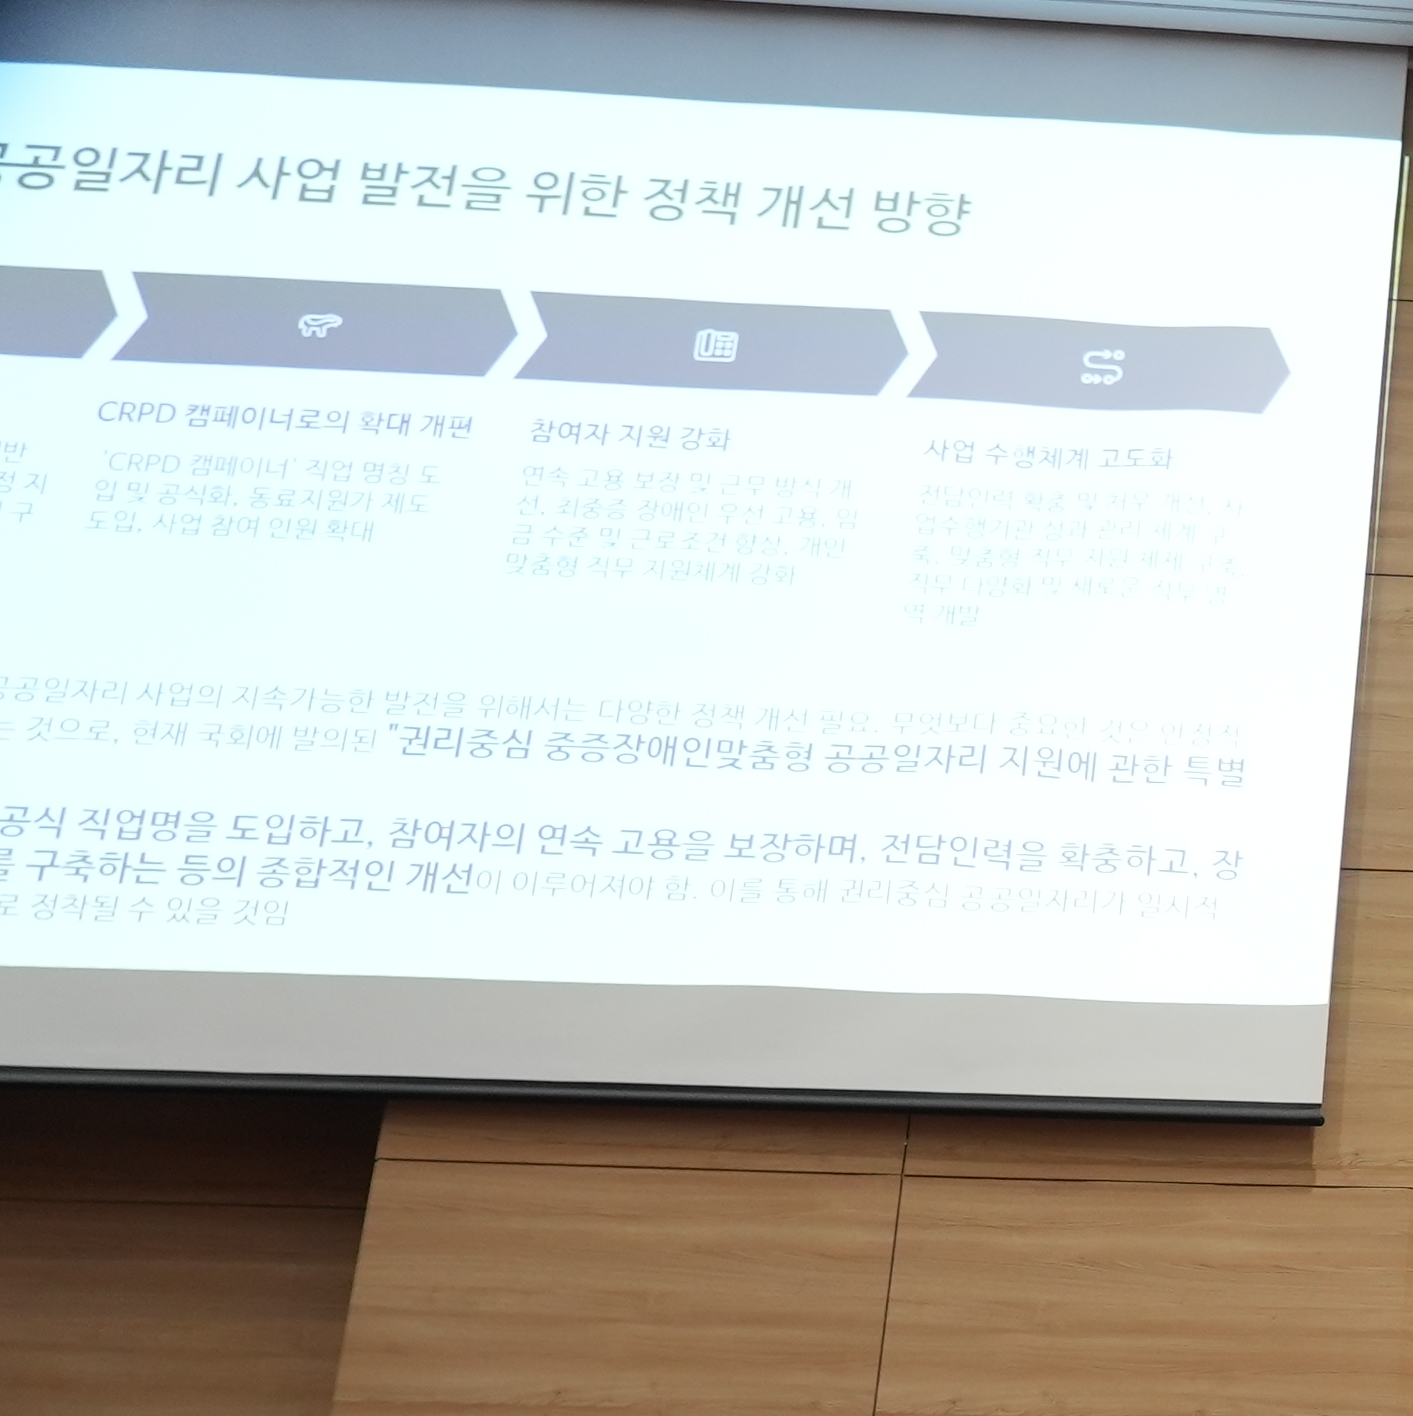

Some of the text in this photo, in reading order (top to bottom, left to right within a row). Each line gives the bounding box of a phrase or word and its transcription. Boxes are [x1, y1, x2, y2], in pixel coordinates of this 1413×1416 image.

[0, 142, 973, 238] 공일자리 사업 발전을 위한 정책 개선 방향
[96, 400, 474, 440] CRPD 캠페이너로의 확대 개편
[530, 418, 733, 453] 참여자 지원 강화
[305, 459, 354, 483] 직업
[361, 461, 410, 486] 명칭
[419, 465, 441, 485] 도
[923, 439, 1174, 471] 사업 수행체계 고도화
[94, 478, 118, 503] 입
[126, 481, 150, 503] 및
[249, 486, 373, 513] 동료지원가
[381, 492, 429, 515] 제도
[151, 513, 203, 536] 사업
[210, 514, 261, 539] 참여
[268, 517, 318, 541] 인원
[326, 518, 375, 544] 확대
[132, 719, 189, 748] 현재
[199, 723, 284, 751] 국회에
[293, 725, 377, 753] 발의된
[544, 731, 814, 773] 중증장애인맞춤형
[824, 743, 988, 775] 공공일자리
[999, 745, 1098, 783] 지원에
[1108, 753, 1173, 785] 관한
[1183, 755, 1246, 789] 특별
[0, 805, 68, 840] 공식
[77, 807, 218, 844] 직업명을
[389, 817, 526, 855] 참여자의
[537, 823, 604, 858] 연속
[611, 828, 715, 862] 고용을
[881, 833, 1047, 873] 전담인력을
[1212, 849, 1245, 882] 장
